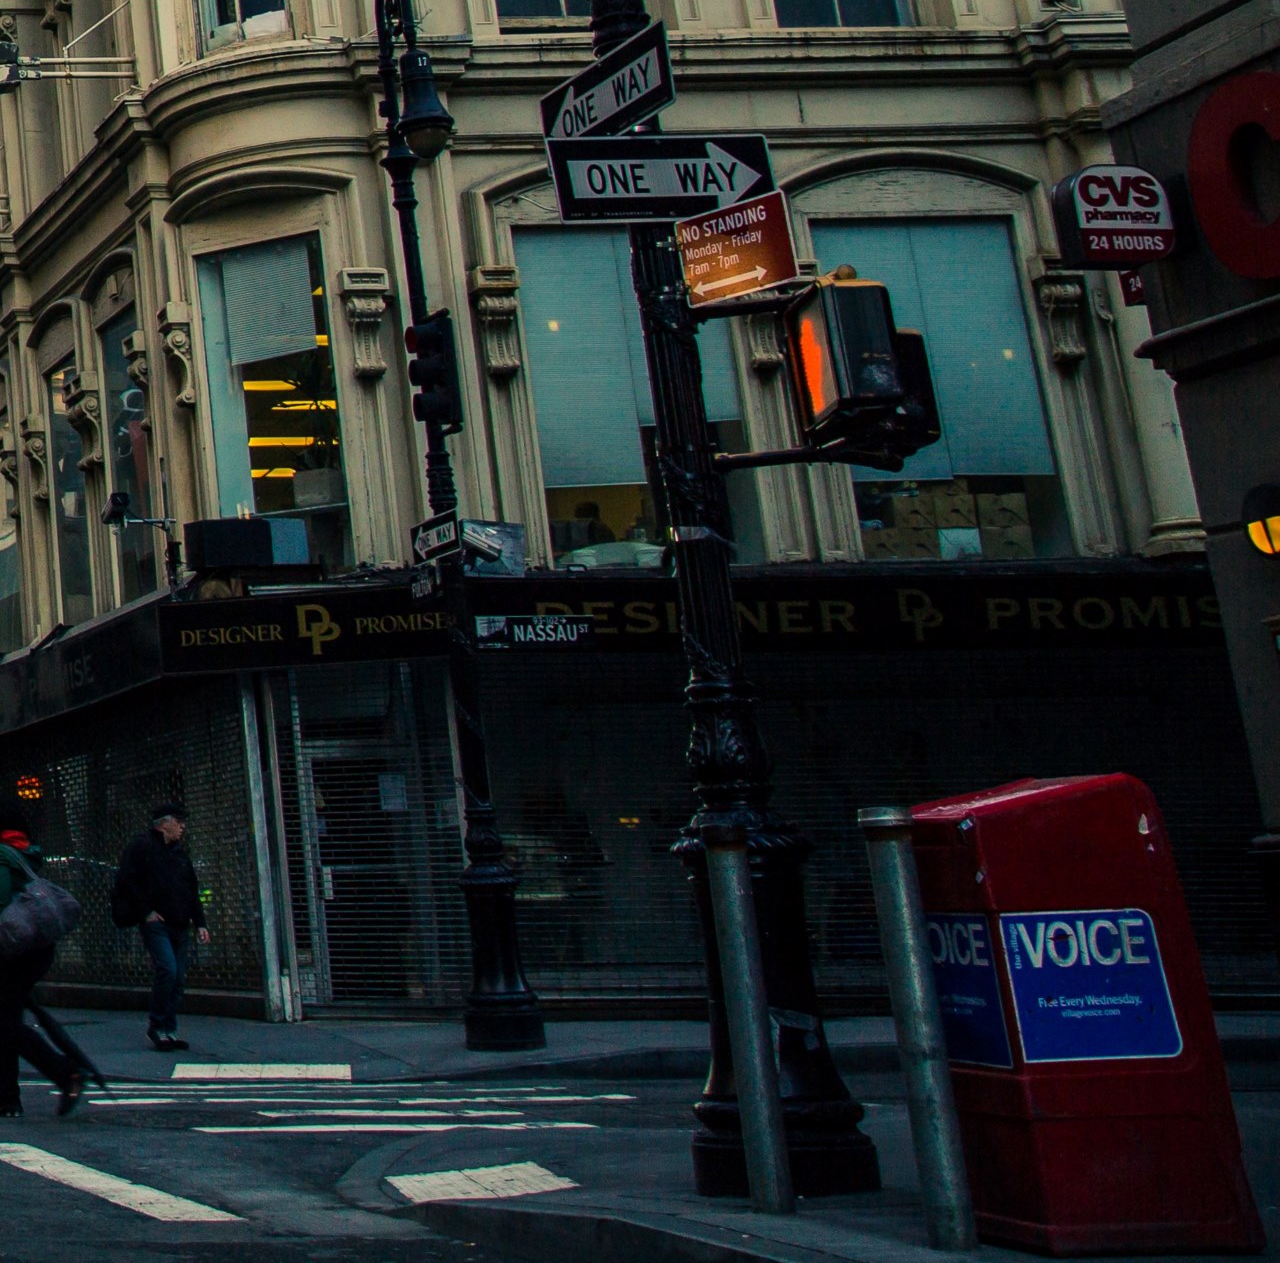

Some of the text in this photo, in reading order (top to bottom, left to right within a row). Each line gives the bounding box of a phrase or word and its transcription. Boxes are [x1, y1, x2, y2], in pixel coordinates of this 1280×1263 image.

[418, 56, 427, 67] 17
[562, 56, 650, 137] ONE WAY
[586, 161, 739, 195] ONE WAY
[1078, 175, 1160, 208] CVS
[681, 204, 767, 244] NO STANDING
[1084, 208, 1161, 225] pharmacy
[685, 240, 724, 262] Monday
[731, 228, 763, 249] Friday
[1089, 235, 1165, 250] 24 HOURS
[688, 261, 710, 278] 7am
[718, 252, 740, 270] 7pm
[419, 523, 454, 553] ONE WAY
[180, 622, 285, 648] DESIGNER
[355, 611, 449, 636] PROMISE
[534, 601, 857, 634] ESINER
[985, 593, 1221, 634] PROMIS
[513, 624, 589, 643] NASSAU ST
[927, 922, 990, 967] OICE
[1016, 918, 1152, 969] VOICE
[1059, 996, 1085, 1009] Every
[1085, 993, 1143, 1007] Wednesday.
[1061, 1008, 1121, 1019] villagevoice.com
